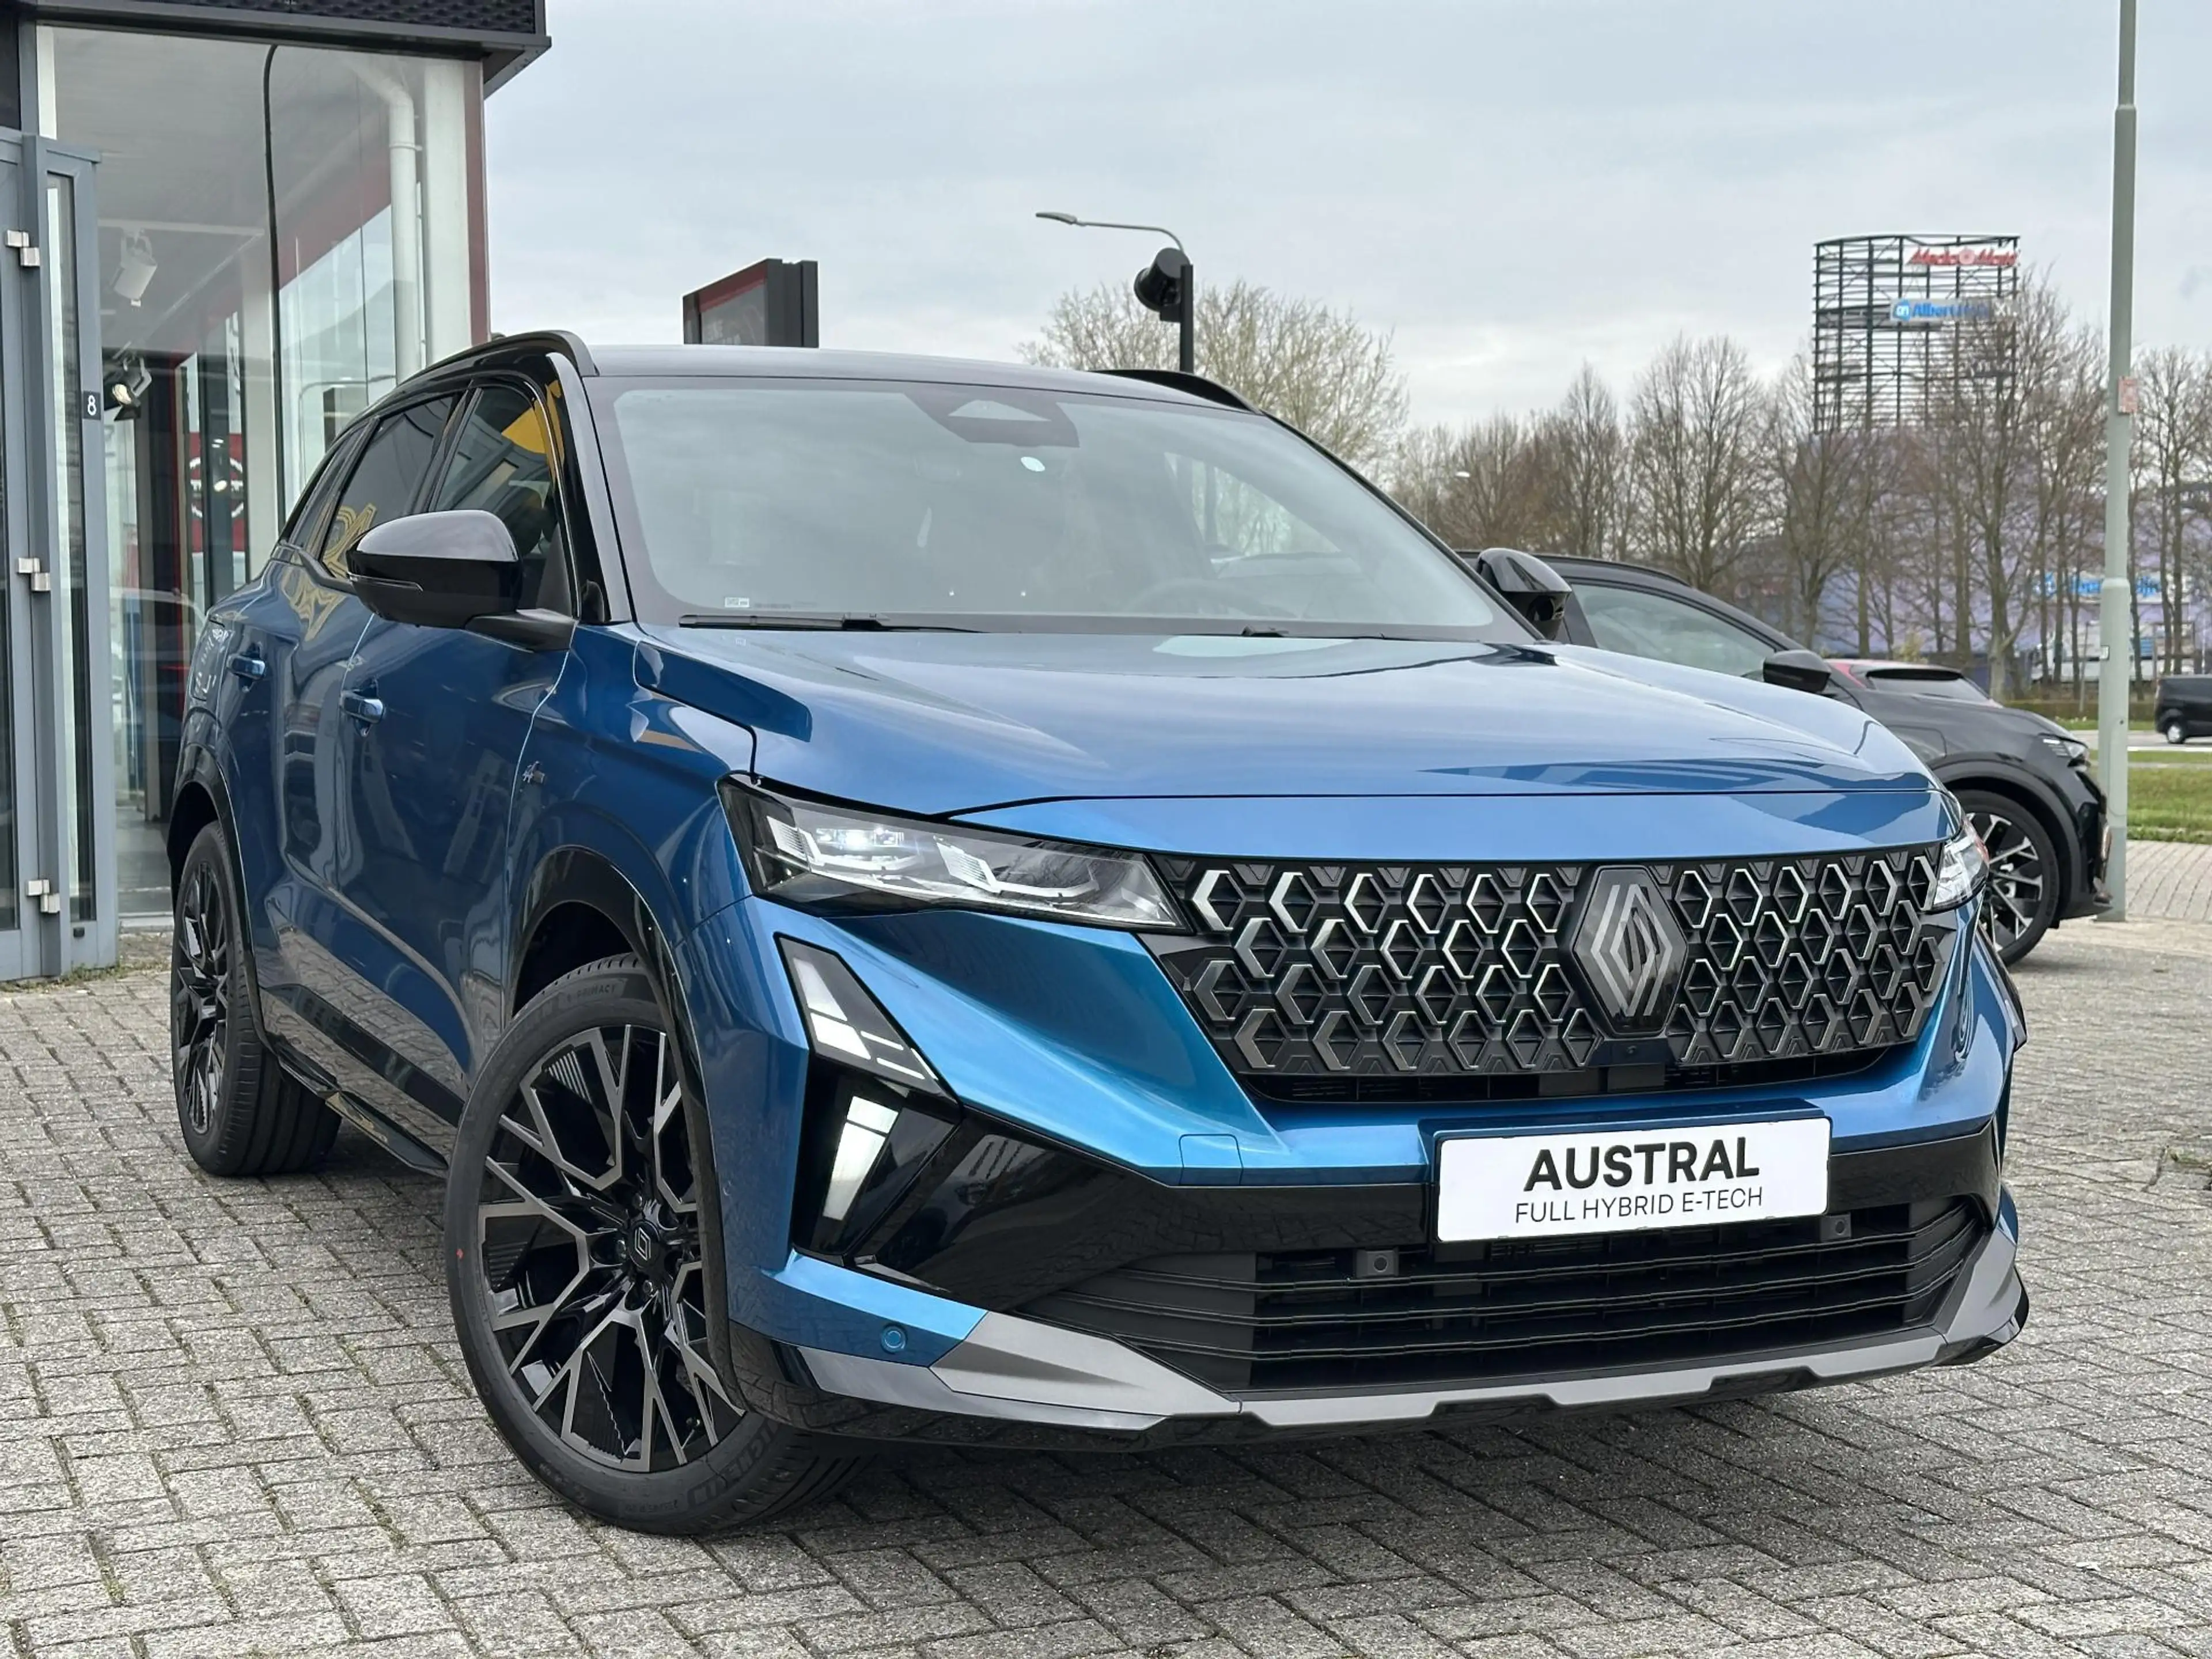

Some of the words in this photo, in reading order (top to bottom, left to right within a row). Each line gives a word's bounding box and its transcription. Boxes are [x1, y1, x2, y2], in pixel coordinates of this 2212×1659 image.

[88, 395, 97, 415] 8
[1524, 1137, 1759, 1192] AUSTRAL
[1516, 1200, 1575, 1223] FULL
[1583, 1194, 1673, 1219] HYBRID
[1683, 1187, 1762, 1212] E-TECH
